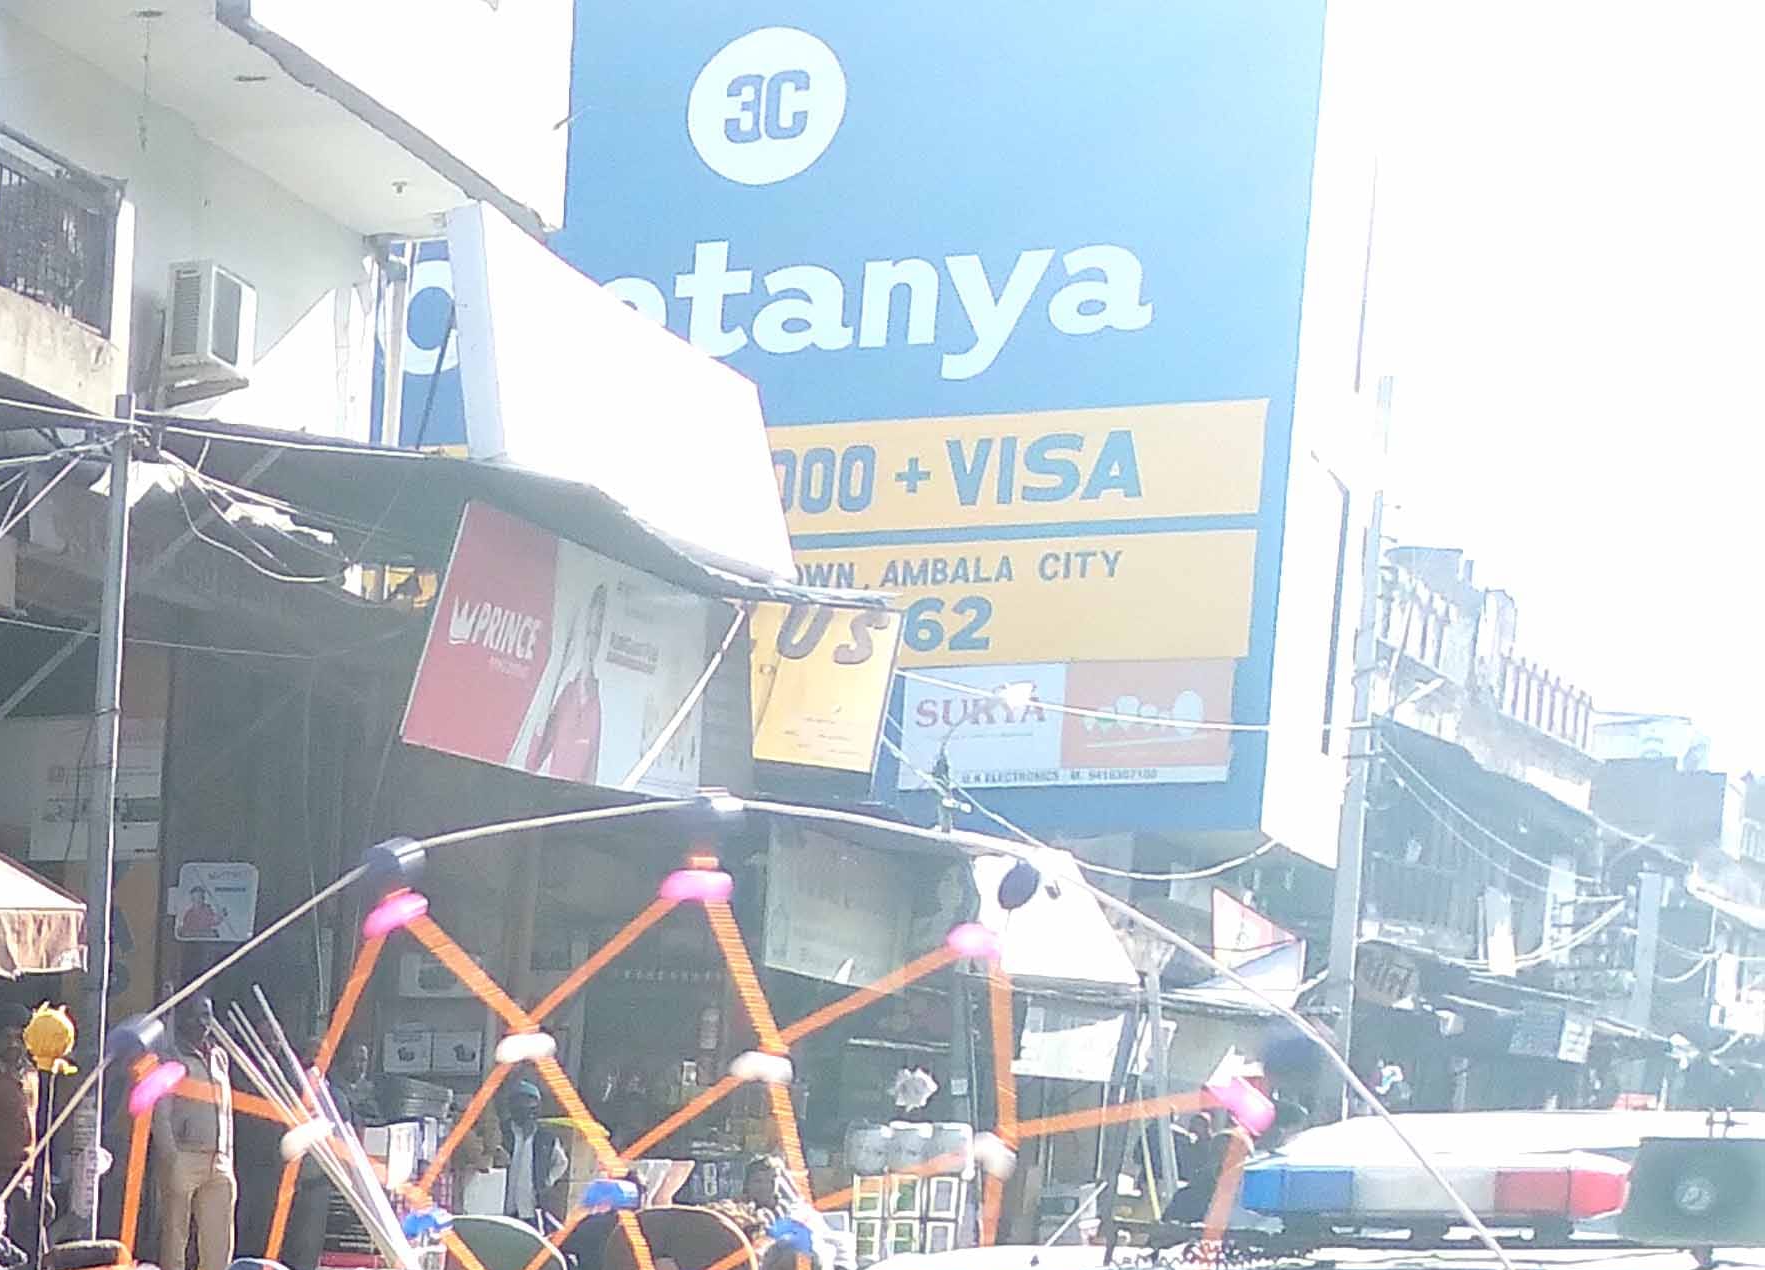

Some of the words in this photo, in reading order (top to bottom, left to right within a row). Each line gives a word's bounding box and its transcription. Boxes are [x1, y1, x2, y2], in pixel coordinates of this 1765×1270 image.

[723, 69, 810, 144] 3C
[946, 430, 1142, 506] VISA
[880, 555, 1013, 588] AMBALA
[1038, 551, 1123, 582] CITY
[472, 602, 542, 661] PRINCE
